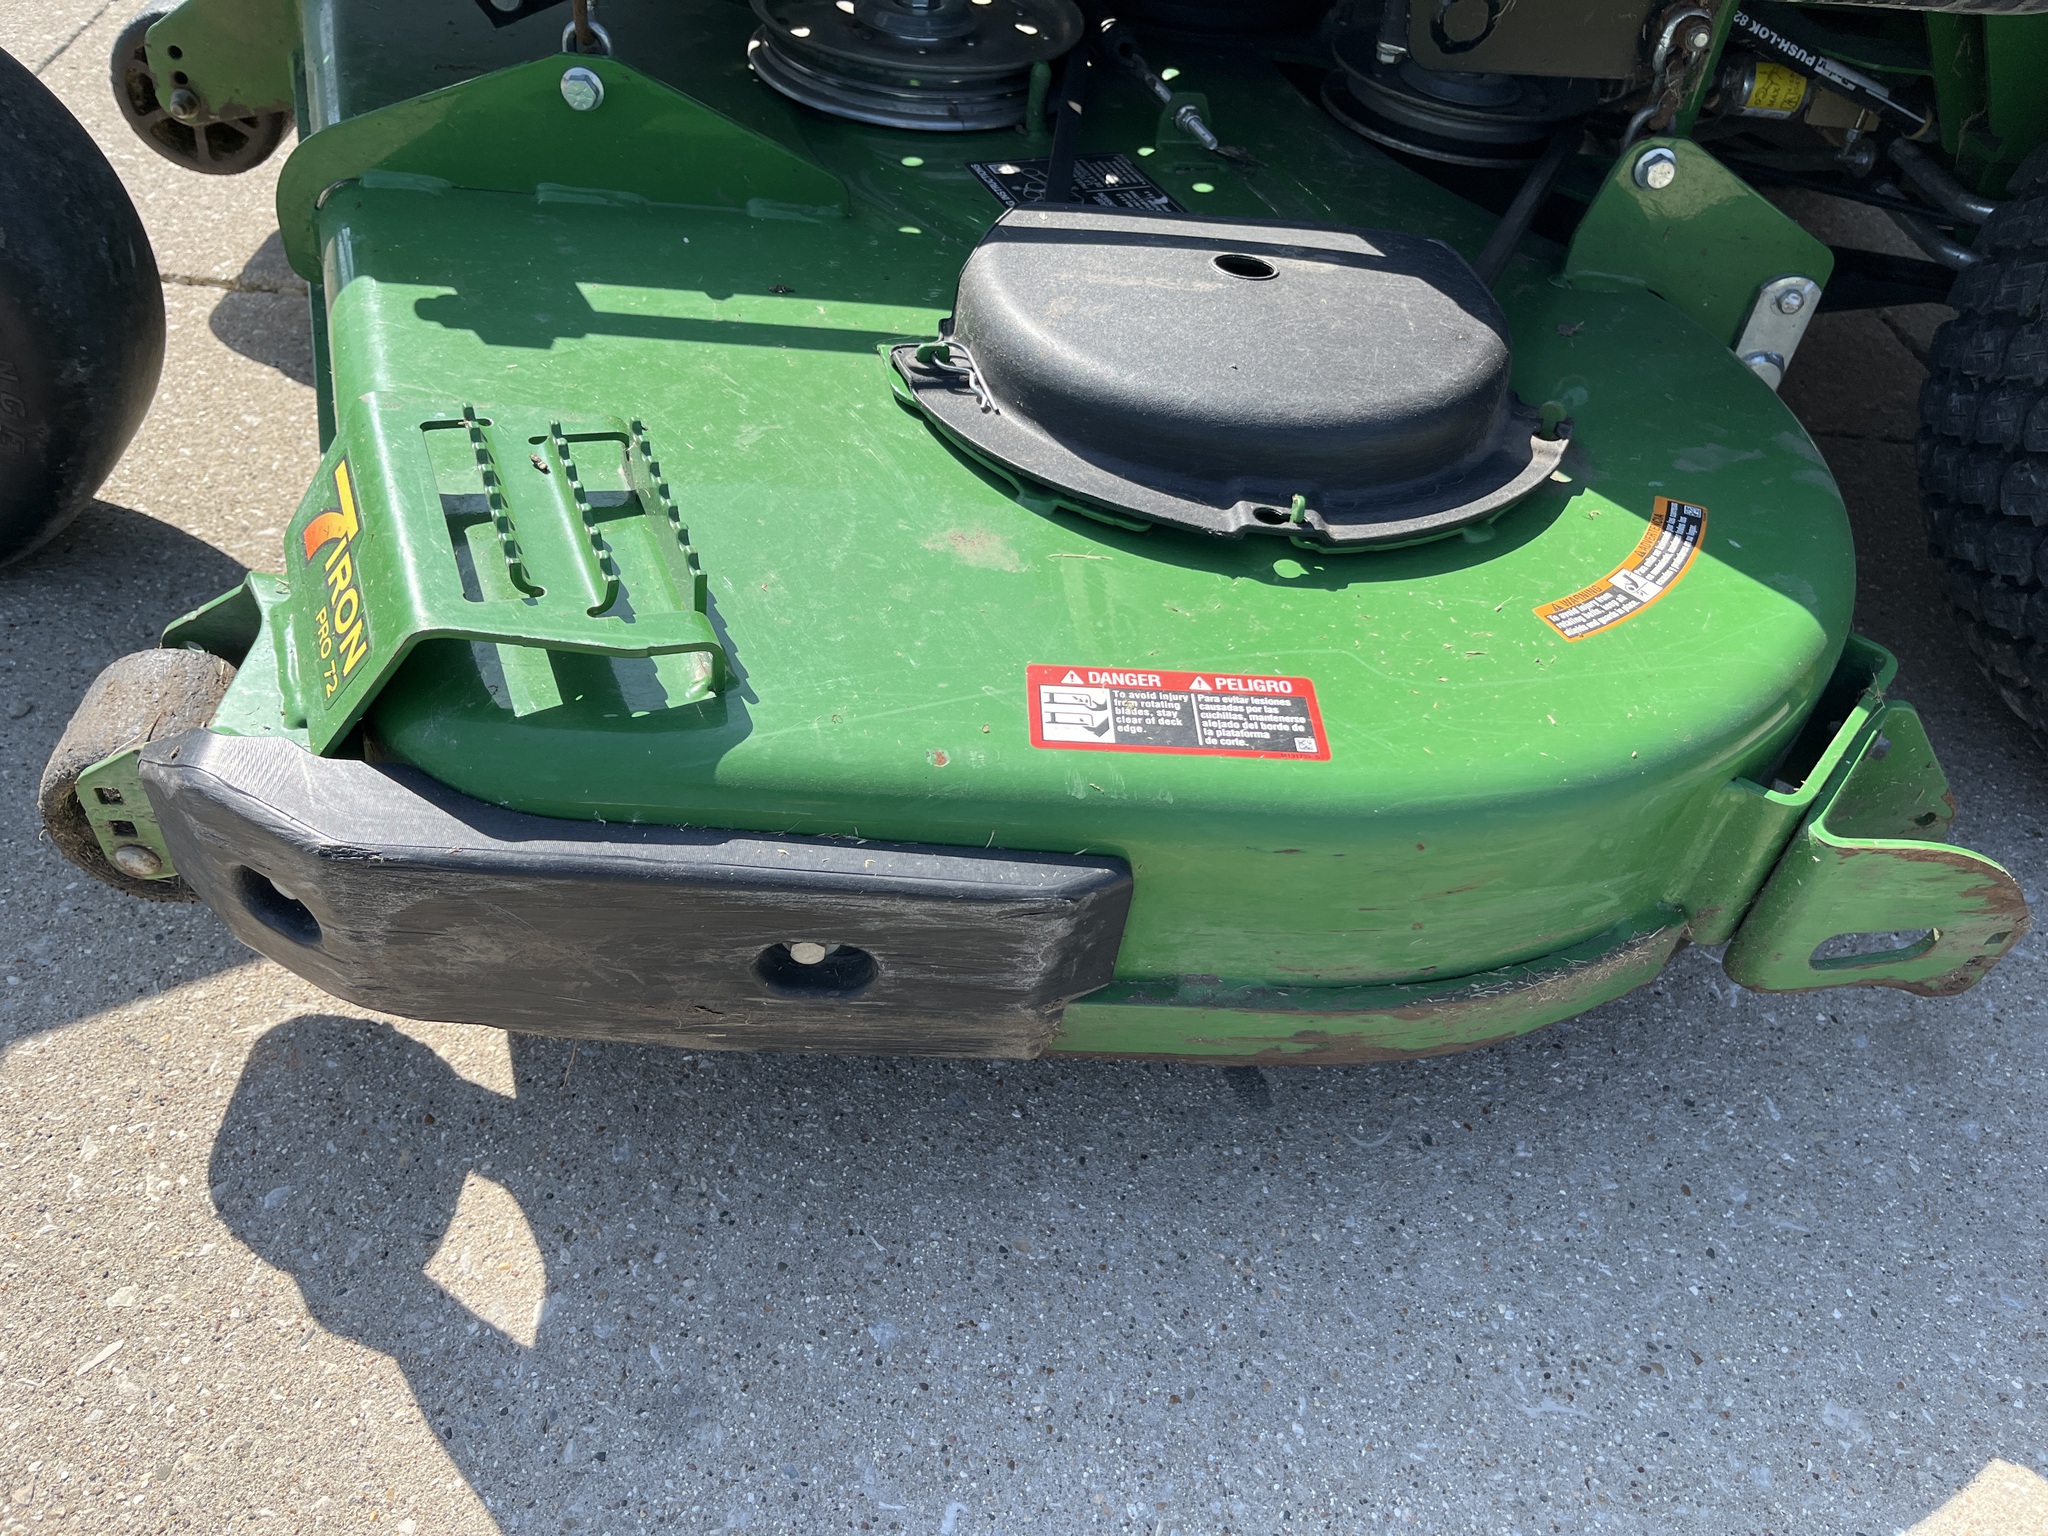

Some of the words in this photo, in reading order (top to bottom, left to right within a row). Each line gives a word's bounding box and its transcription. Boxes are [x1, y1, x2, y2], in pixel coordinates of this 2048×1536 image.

[1748, 20, 1816, 67] PUSH-LOK
[1640, 514, 1664, 553] ADVERTENCIA
[1560, 584, 1603, 606] WARNING
[1556, 615, 1587, 629] rotating
[1600, 600, 1620, 611] keep
[1615, 594, 1628, 602] all
[1558, 607, 1580, 619] avoid
[1576, 600, 1600, 612] injury
[1594, 593, 1613, 603] from
[1586, 619, 1600, 628] and
[315, 605, 332, 660] PRO
[323, 659, 339, 699] 72
[1088, 671, 1161, 687] DANGER
[1215, 678, 1292, 693] PELIGRO
[1113, 690, 1126, 698] To
[1159, 693, 1188, 702] injury
[1198, 695, 1219, 703] Para
[1221, 696, 1249, 704] evitar
[1251, 697, 1291, 706] lesiones
[1141, 701, 1180, 710] rotating
[1199, 703, 1244, 711] causadas
[1264, 705, 1279, 713] las
[1157, 710, 1177, 718] stay
[1201, 712, 1247, 721] cuchillas,
[1249, 714, 1306, 723] mantenerse
[1116, 716, 1142, 724] clear
[1159, 718, 1183, 726] deck
[1202, 720, 1239, 729] alejado
[1242, 721, 1258, 730] del
[1260, 722, 1289, 731] borde
[1292, 724, 1305, 732] de
[1117, 725, 1146, 733] edge.
[1204, 728, 1214, 736] la
[1216, 729, 1270, 739] plataforma
[1205, 737, 1218, 745] de
[1220, 738, 1249, 746] corte.
